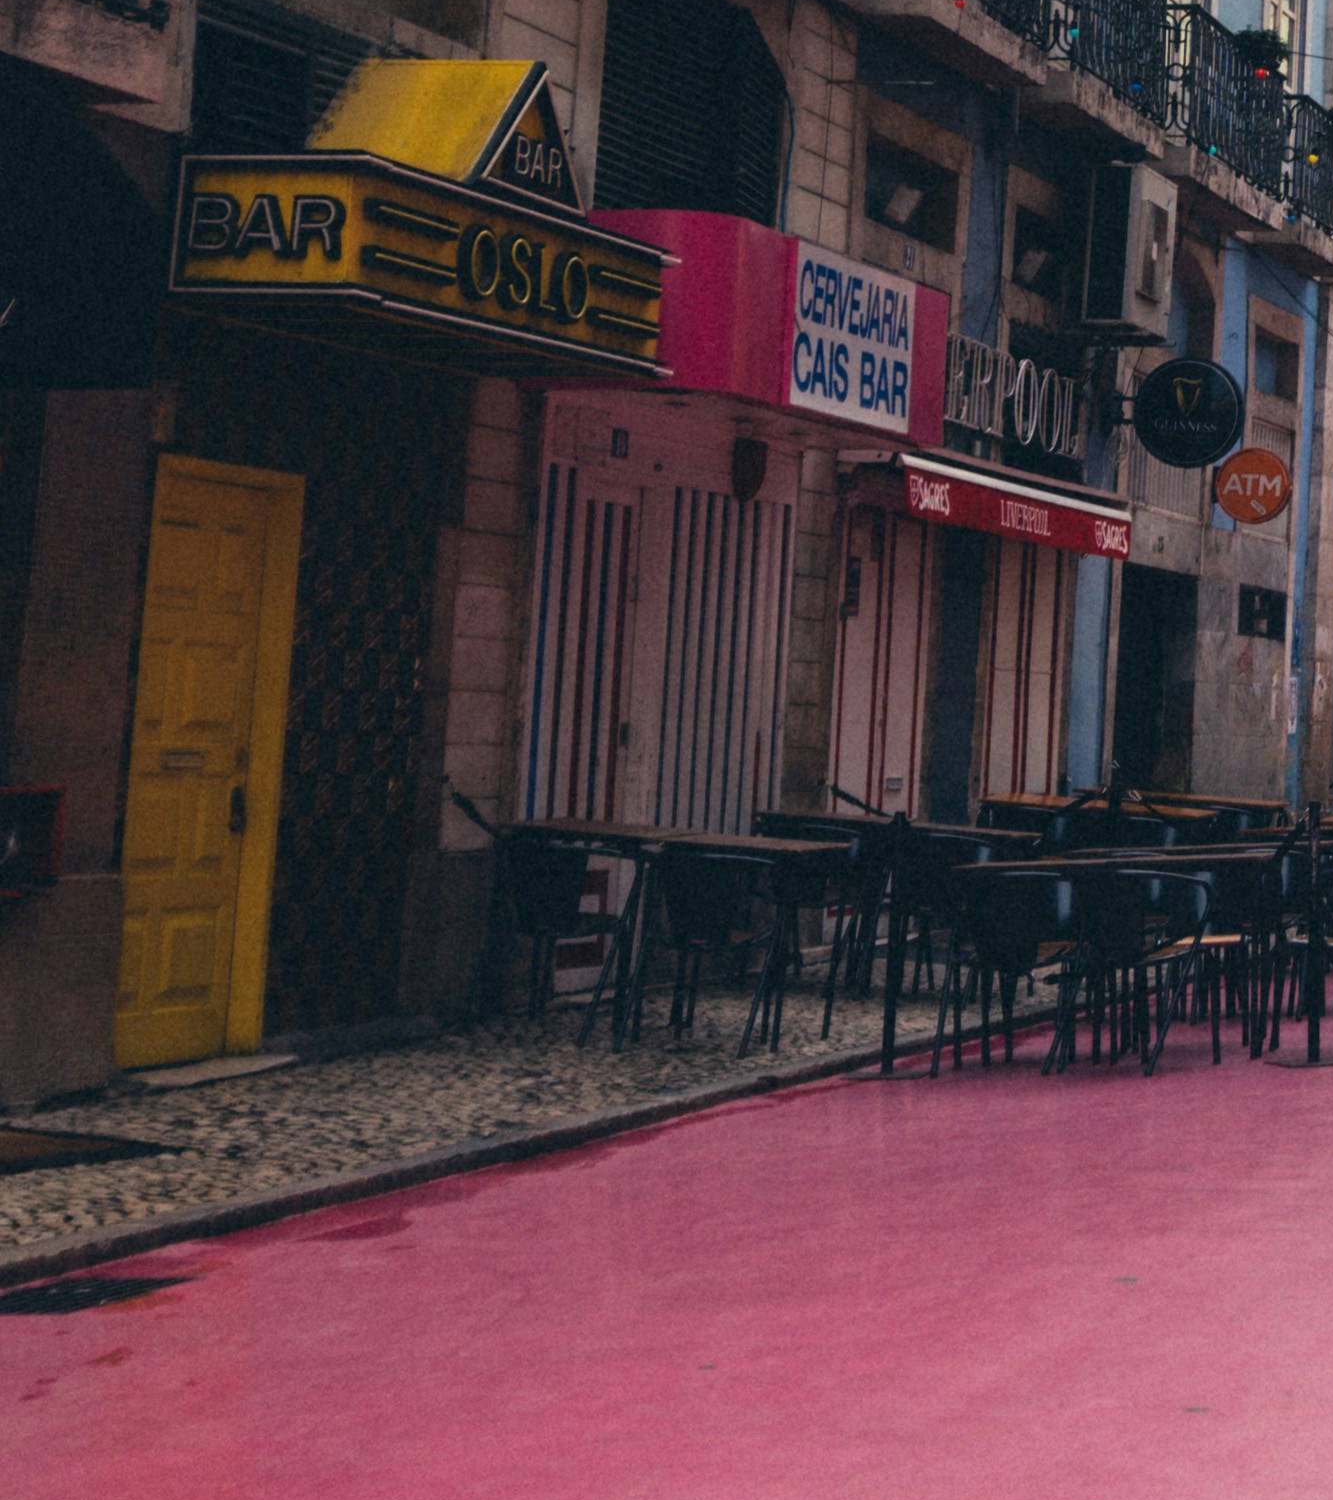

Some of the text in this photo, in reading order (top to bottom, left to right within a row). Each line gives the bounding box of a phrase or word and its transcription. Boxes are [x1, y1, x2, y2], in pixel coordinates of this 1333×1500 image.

[512, 134, 563, 189] BAR
[187, 195, 340, 255] BAR
[467, 227, 590, 321] OSLO
[799, 259, 909, 352] CERVEJARIA
[792, 332, 909, 419] CAIS BAR
[1153, 416, 1218, 436] GUINNESS
[918, 475, 951, 517] SAGRES
[1000, 499, 1052, 537] LIVERPOOL
[1101, 522, 1129, 555] SAGRES
[1222, 473, 1282, 498] ATM
